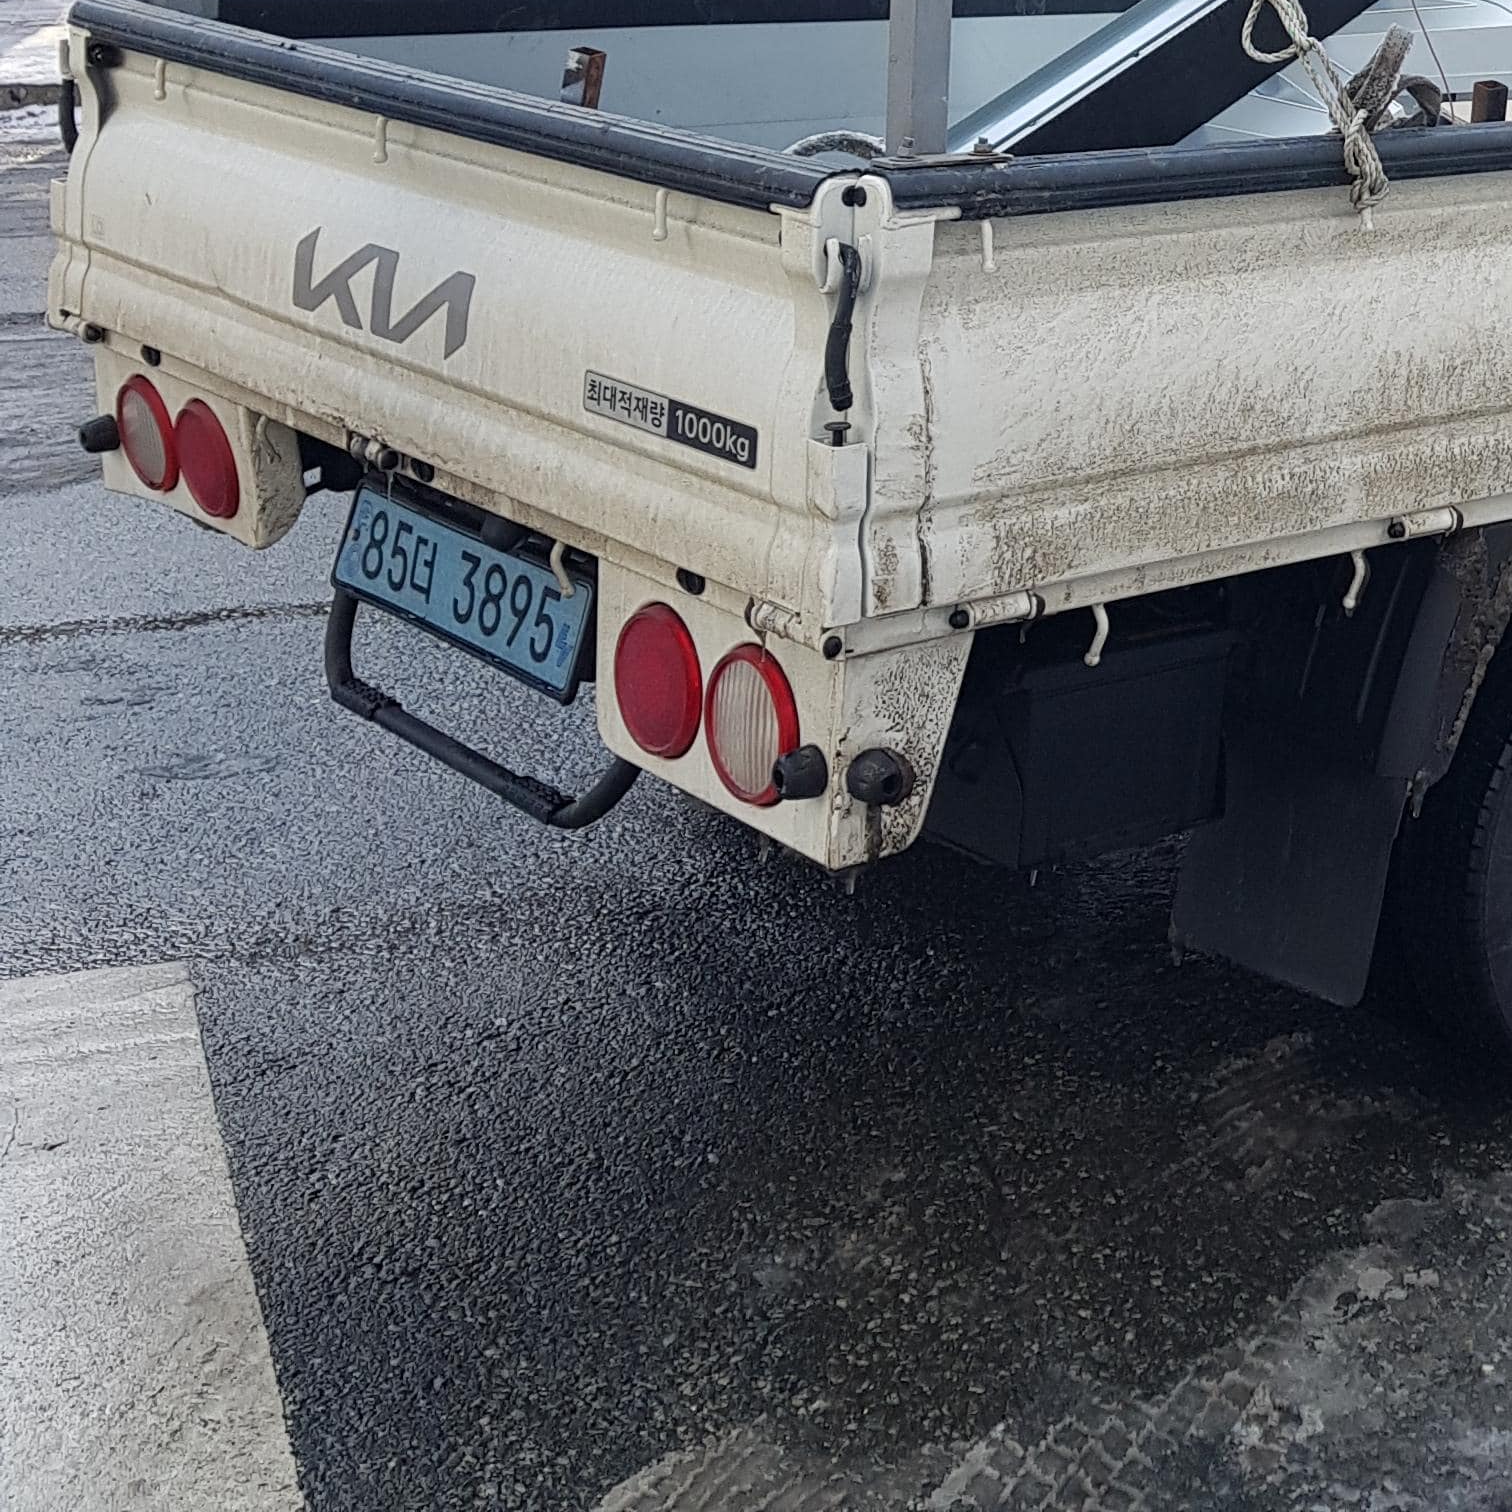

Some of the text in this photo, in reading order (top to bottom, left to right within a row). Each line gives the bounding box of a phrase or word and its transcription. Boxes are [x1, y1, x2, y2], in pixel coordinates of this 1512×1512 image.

[293, 226, 476, 360] KIA
[587, 379, 750, 462] 최대적재량 1000kg
[361, 510, 438, 605] 85더
[453, 549, 562, 664] 3895
